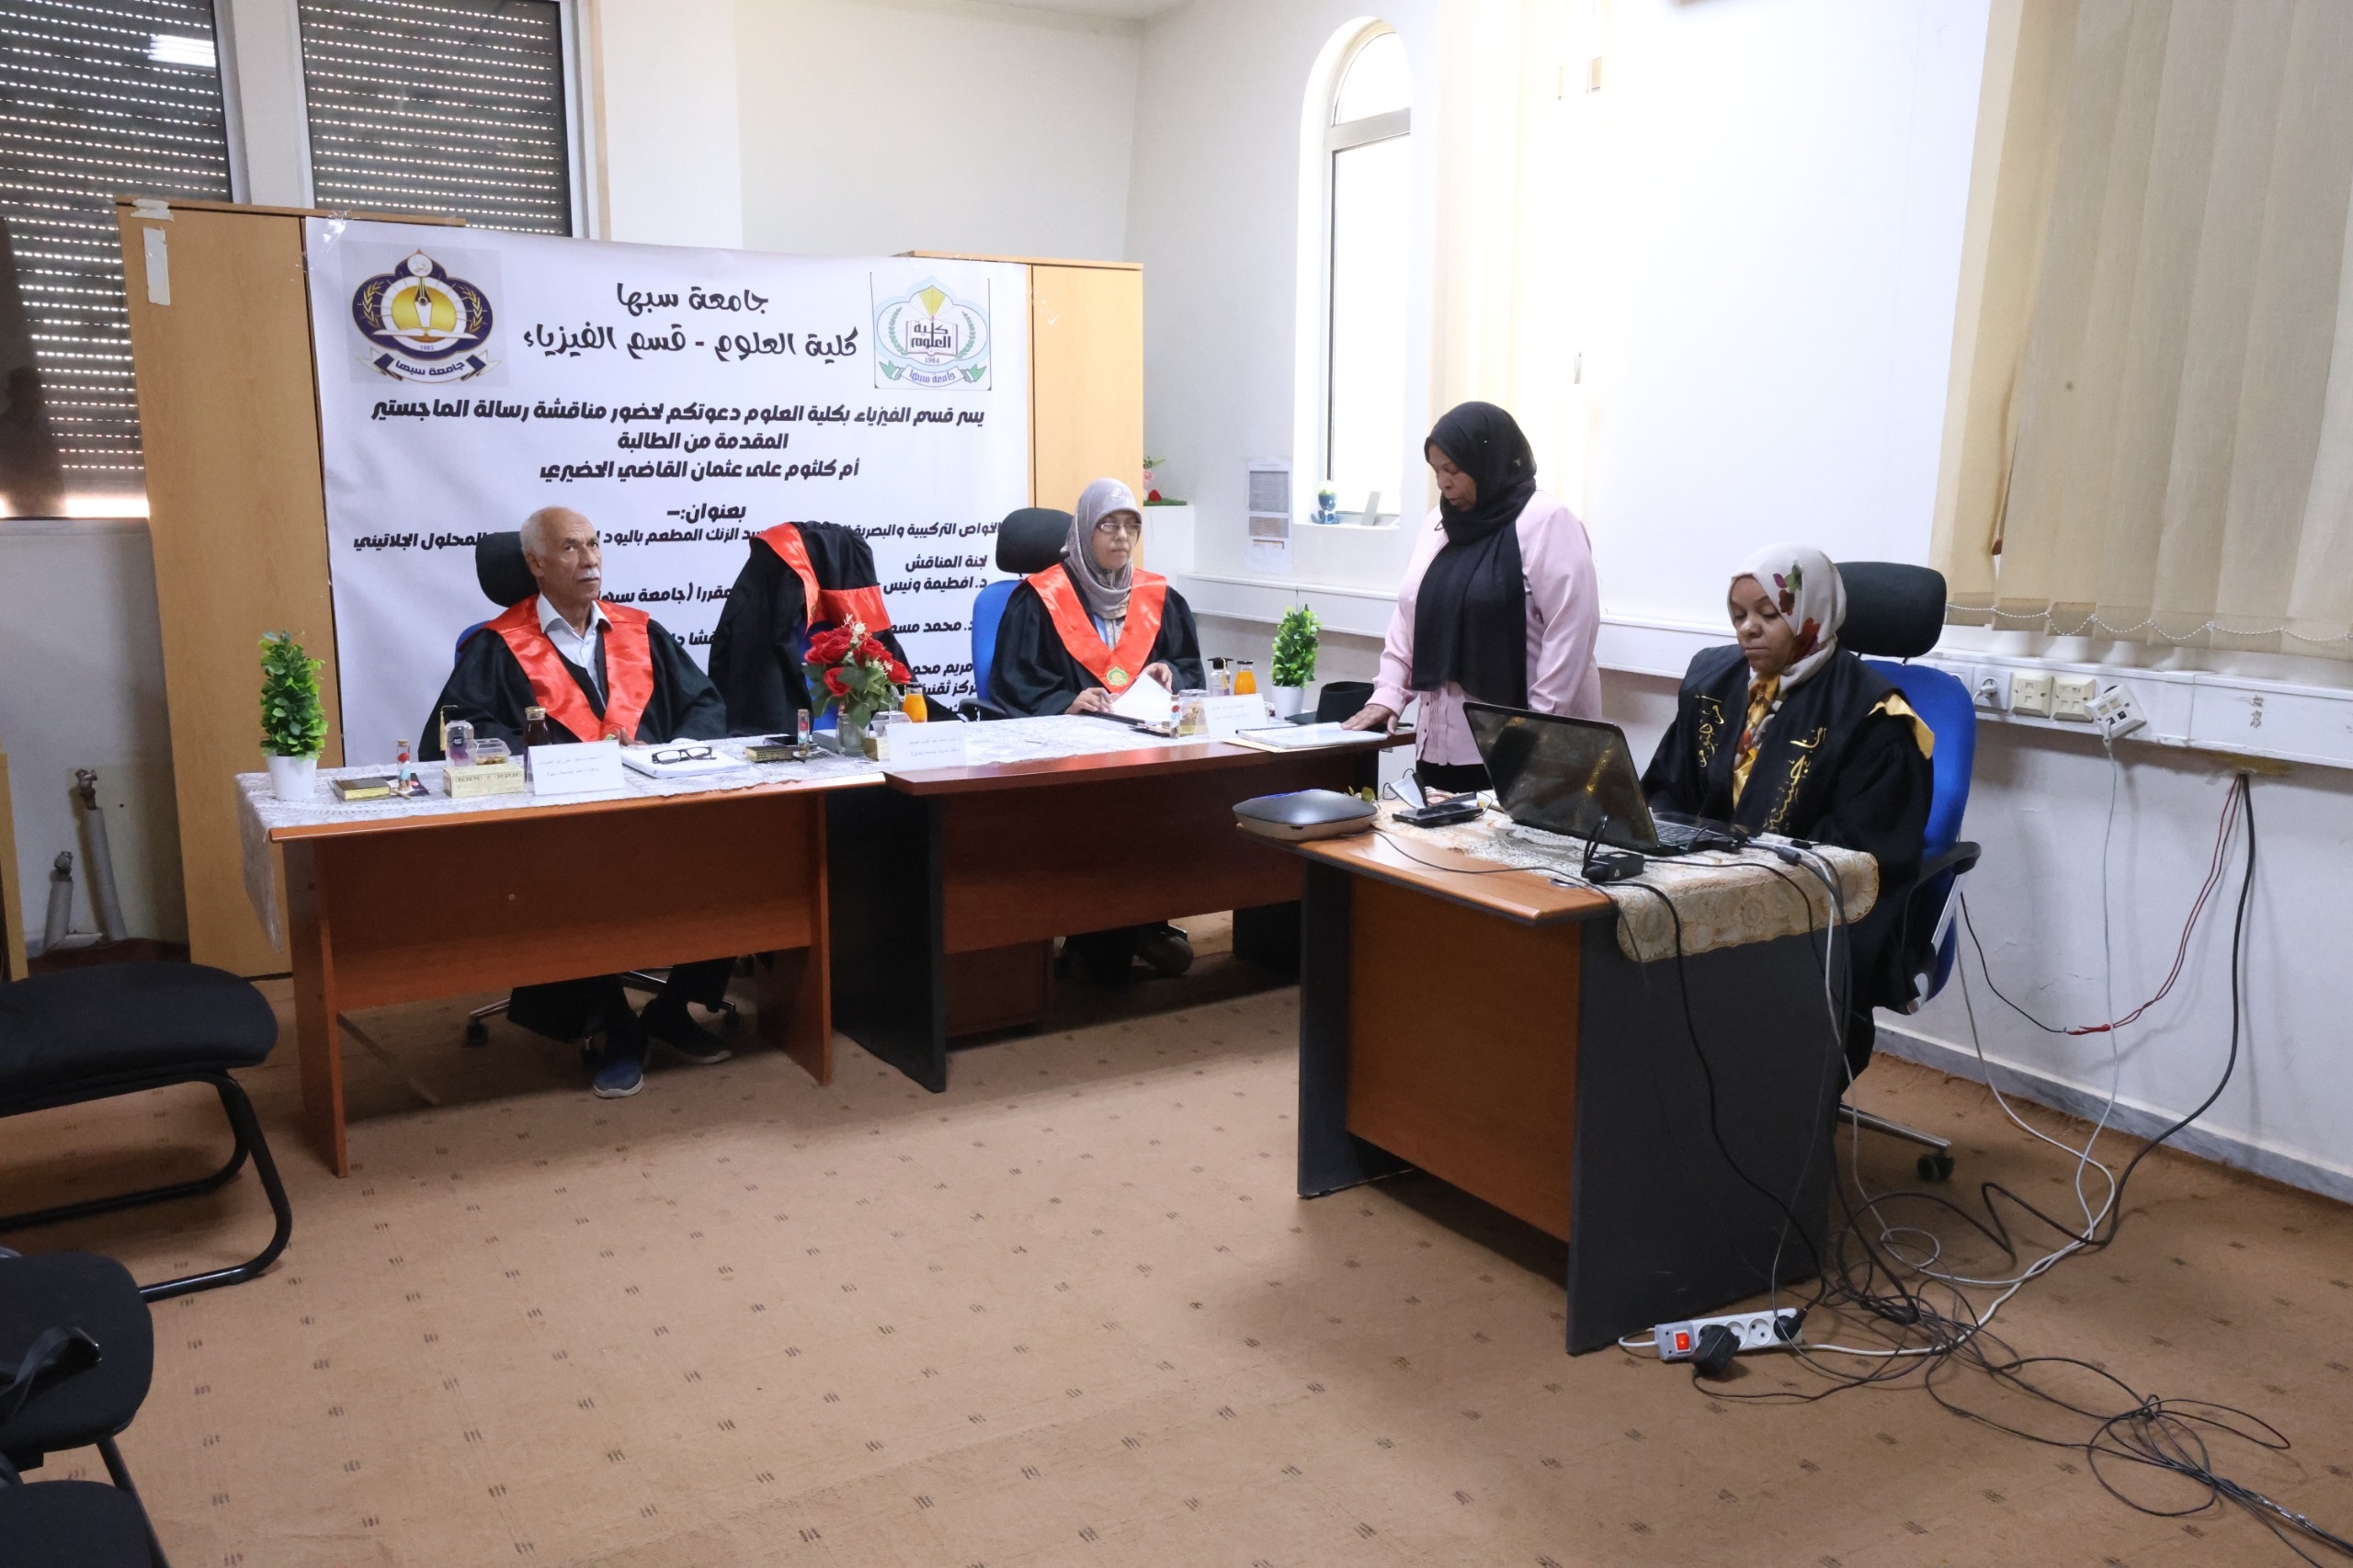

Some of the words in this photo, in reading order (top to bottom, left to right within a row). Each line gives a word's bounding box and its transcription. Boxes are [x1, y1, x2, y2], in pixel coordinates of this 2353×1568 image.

[617, 282, 679, 317] سبها
[688, 286, 769, 314] جامعة
[914, 321, 949, 335] كلية
[523, 321, 618, 358] الفيزياء
[626, 323, 687, 360] قسم
[713, 331, 797, 362] العلوم
[804, 326, 858, 365] كلية
[911, 336, 951, 349] العلوم
[395, 358, 426, 376] سبها
[428, 361, 465, 377] جامعة
[370, 398, 471, 422] الماجستير
[472, 399, 529, 423] رسالة
[533, 397, 608, 420] مناقشة
[609, 402, 665, 425] لحضور
[665, 401, 742, 426] دعوتكم
[743, 404, 805, 426] العلوم
[807, 403, 851, 426] بكلية
[853, 406, 912, 426] الفيزياء
[912, 407, 954, 427] قسم
[955, 411, 985, 427] يسر
[617, 431, 682, 454] الطالبة
[683, 433, 711, 454] من
[714, 432, 790, 449] المقدمة
[617, 460, 688, 483] القاضي
[690, 459, 743, 483] عثمان
[784, 459, 837, 482] كلثوم
[838, 457, 860, 481] أم
[603, 529, 644, 547] باليود
[644, 528, 704, 546] المطعم
[705, 527, 740, 544] الزنك
[906, 521, 957, 539] التركيبية
[958, 520, 1002, 538] الخواص
[353, 532, 419, 551] الجلاتيني
[420, 531, 487, 551] لمحلول
[964, 554, 988, 571] لجنة
[637, 582, 694, 605] (جامعة
[882, 577, 922, 596] ونيس
[923, 575, 974, 593] افطيمة
[922, 620, 962, 633] محمد
[913, 664, 941, 676] محم
